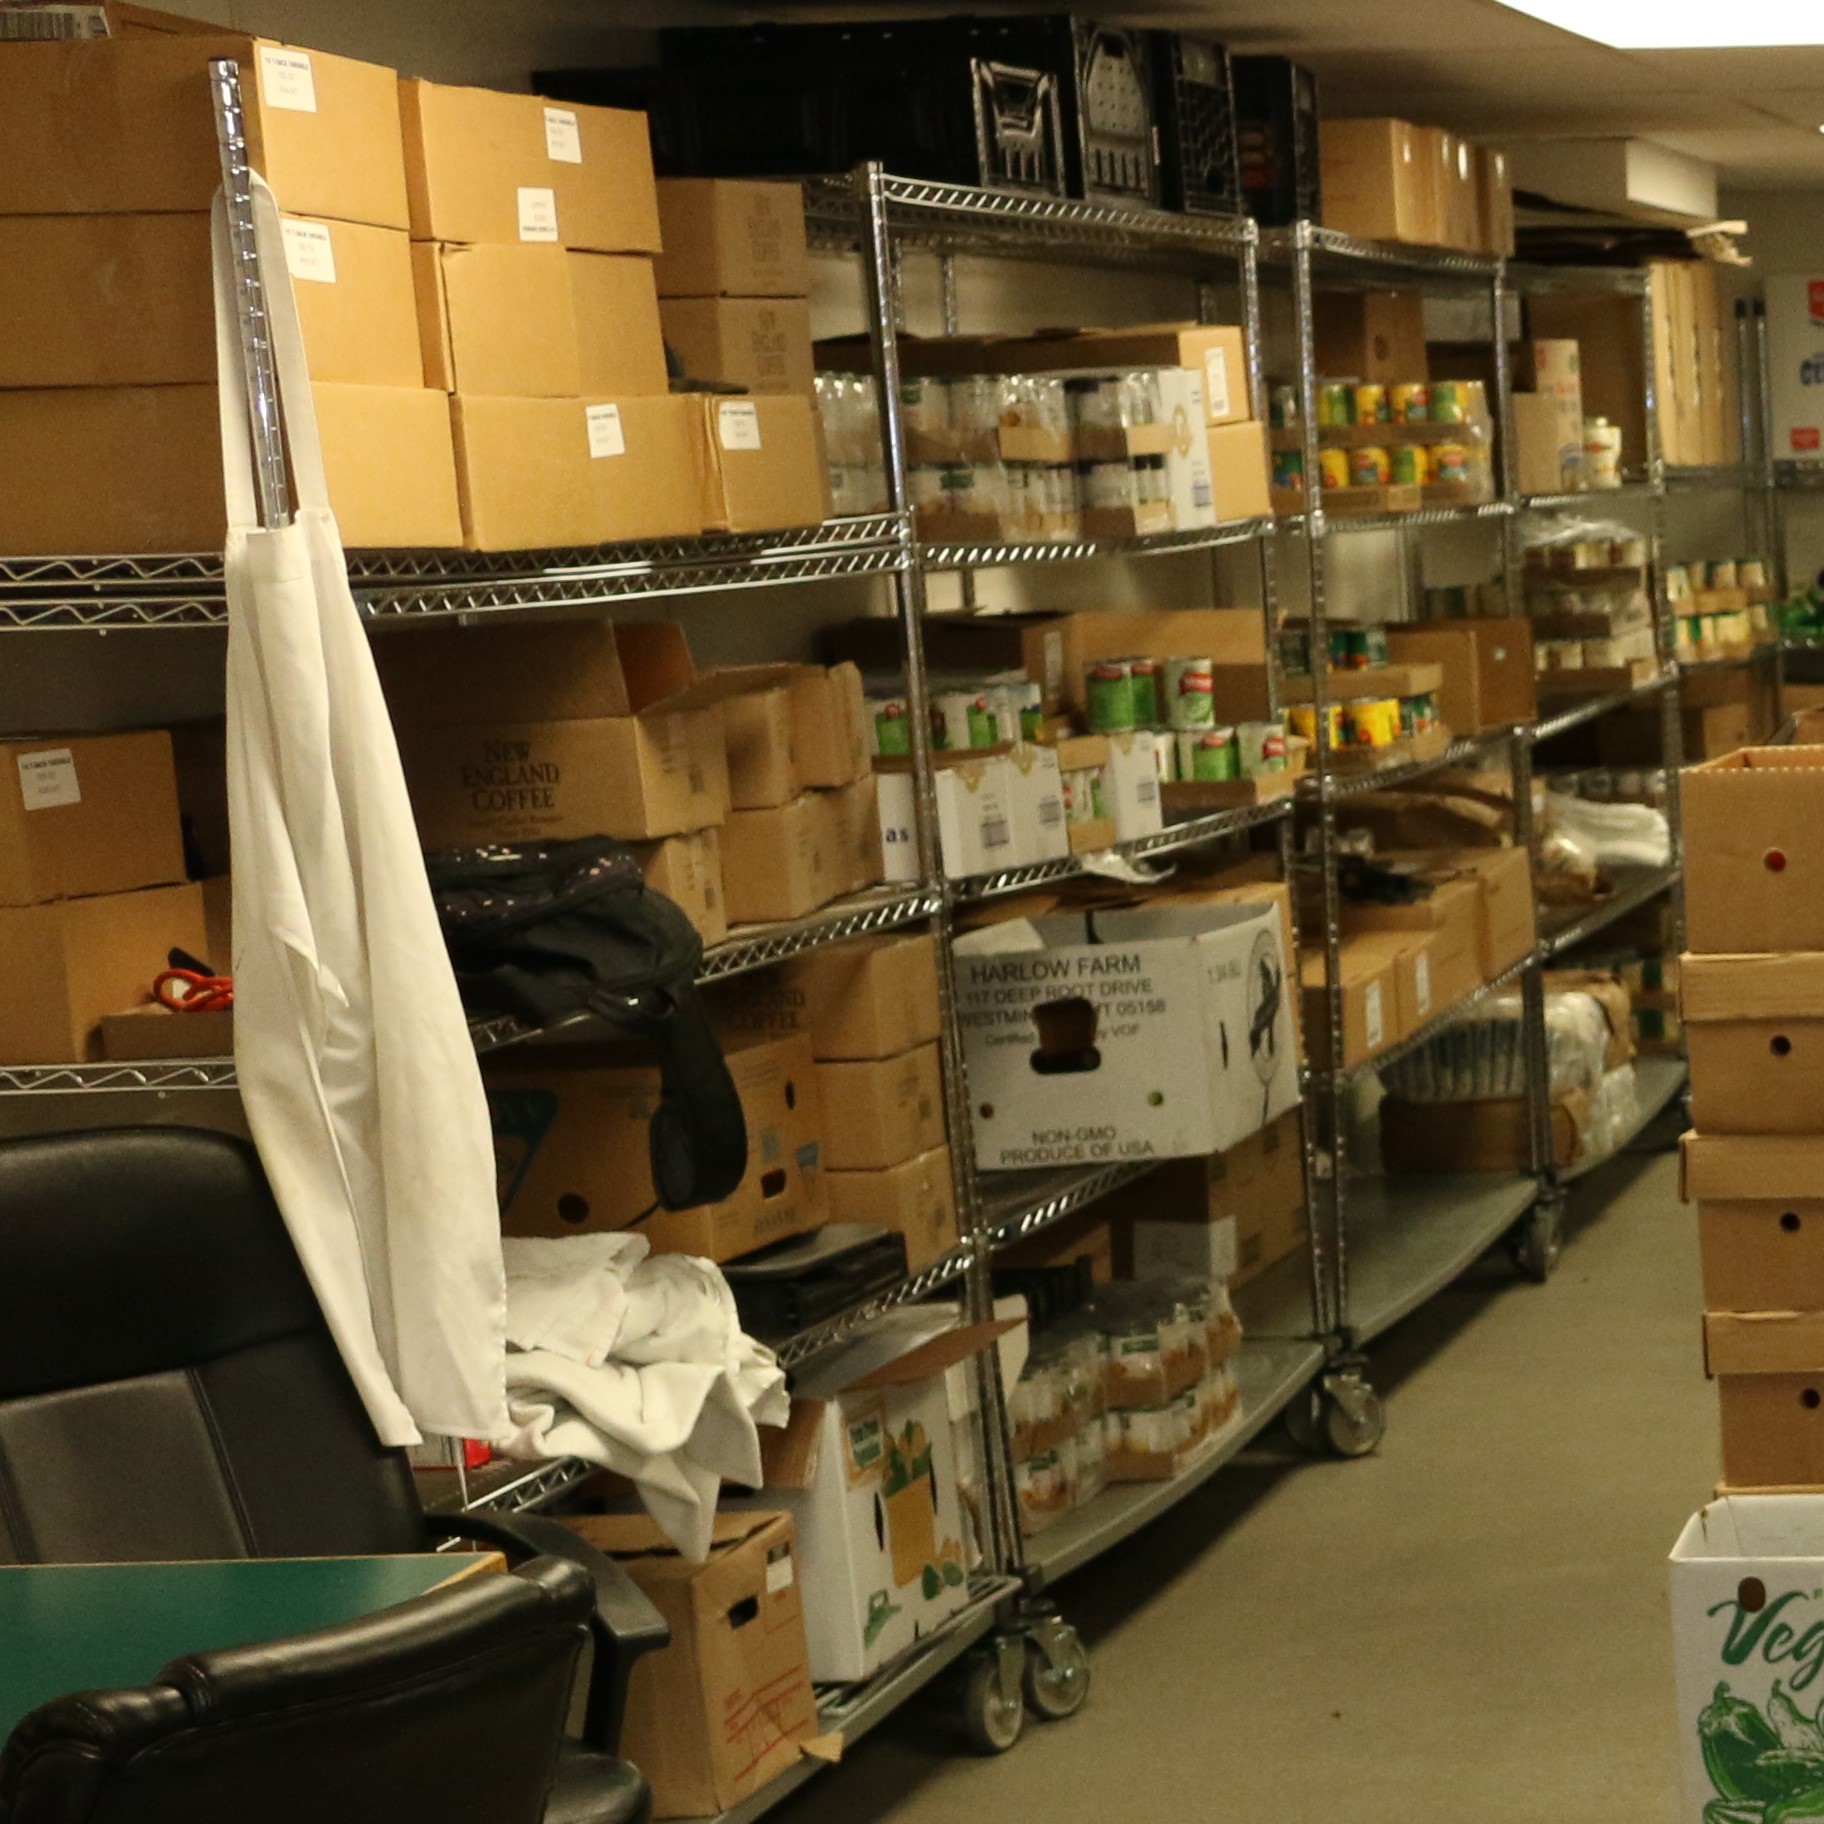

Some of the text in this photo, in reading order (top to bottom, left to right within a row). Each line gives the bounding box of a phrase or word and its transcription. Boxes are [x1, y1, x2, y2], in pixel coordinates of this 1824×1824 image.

[483, 739, 531, 763] NEW
[461, 763, 560, 788] ENGLAND
[472, 786, 555, 812] COFFEE
[970, 953, 1141, 984] HARLOW FARM
[1100, 977, 1152, 997] DRIVE
[961, 1010, 1031, 1027] WESTMIN
[1032, 1125, 1116, 1144] NON-GMO
[1000, 1138, 1155, 1164] PRODUCE OF USA
